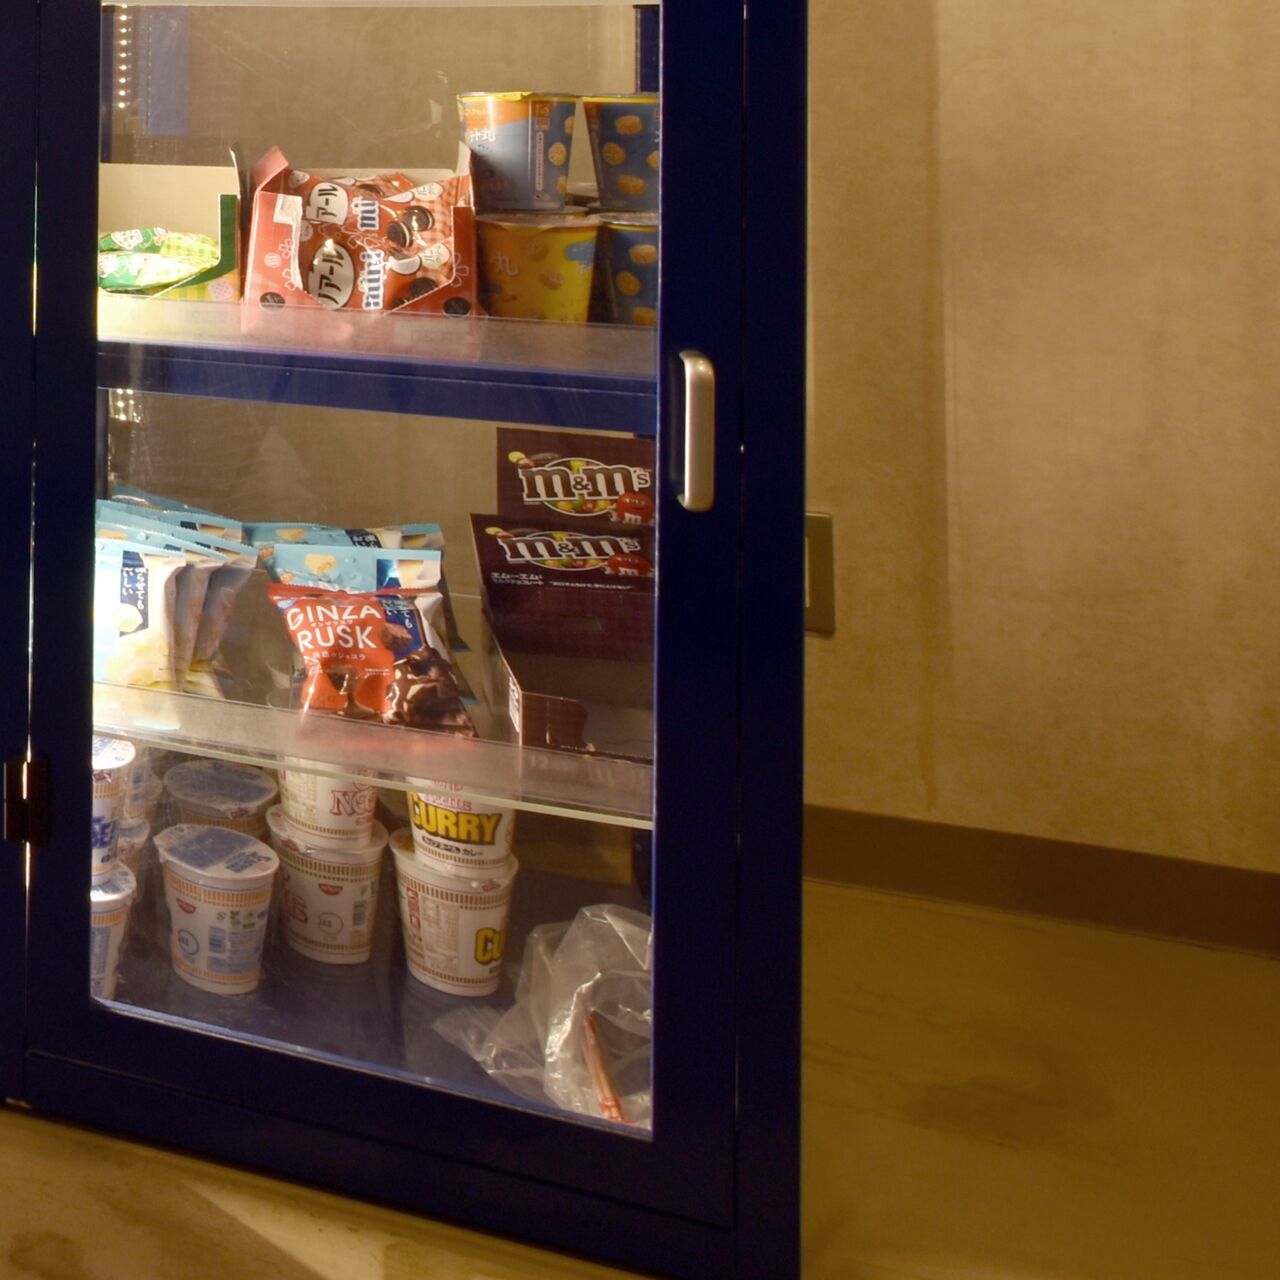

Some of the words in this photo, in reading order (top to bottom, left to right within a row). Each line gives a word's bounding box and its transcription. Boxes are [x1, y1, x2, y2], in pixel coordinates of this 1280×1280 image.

[518, 466, 652, 501] m&m's
[498, 536, 641, 559] m&m's
[286, 604, 382, 632] GINZA
[297, 625, 378, 650] RUSK
[411, 802, 503, 845] CURRY
